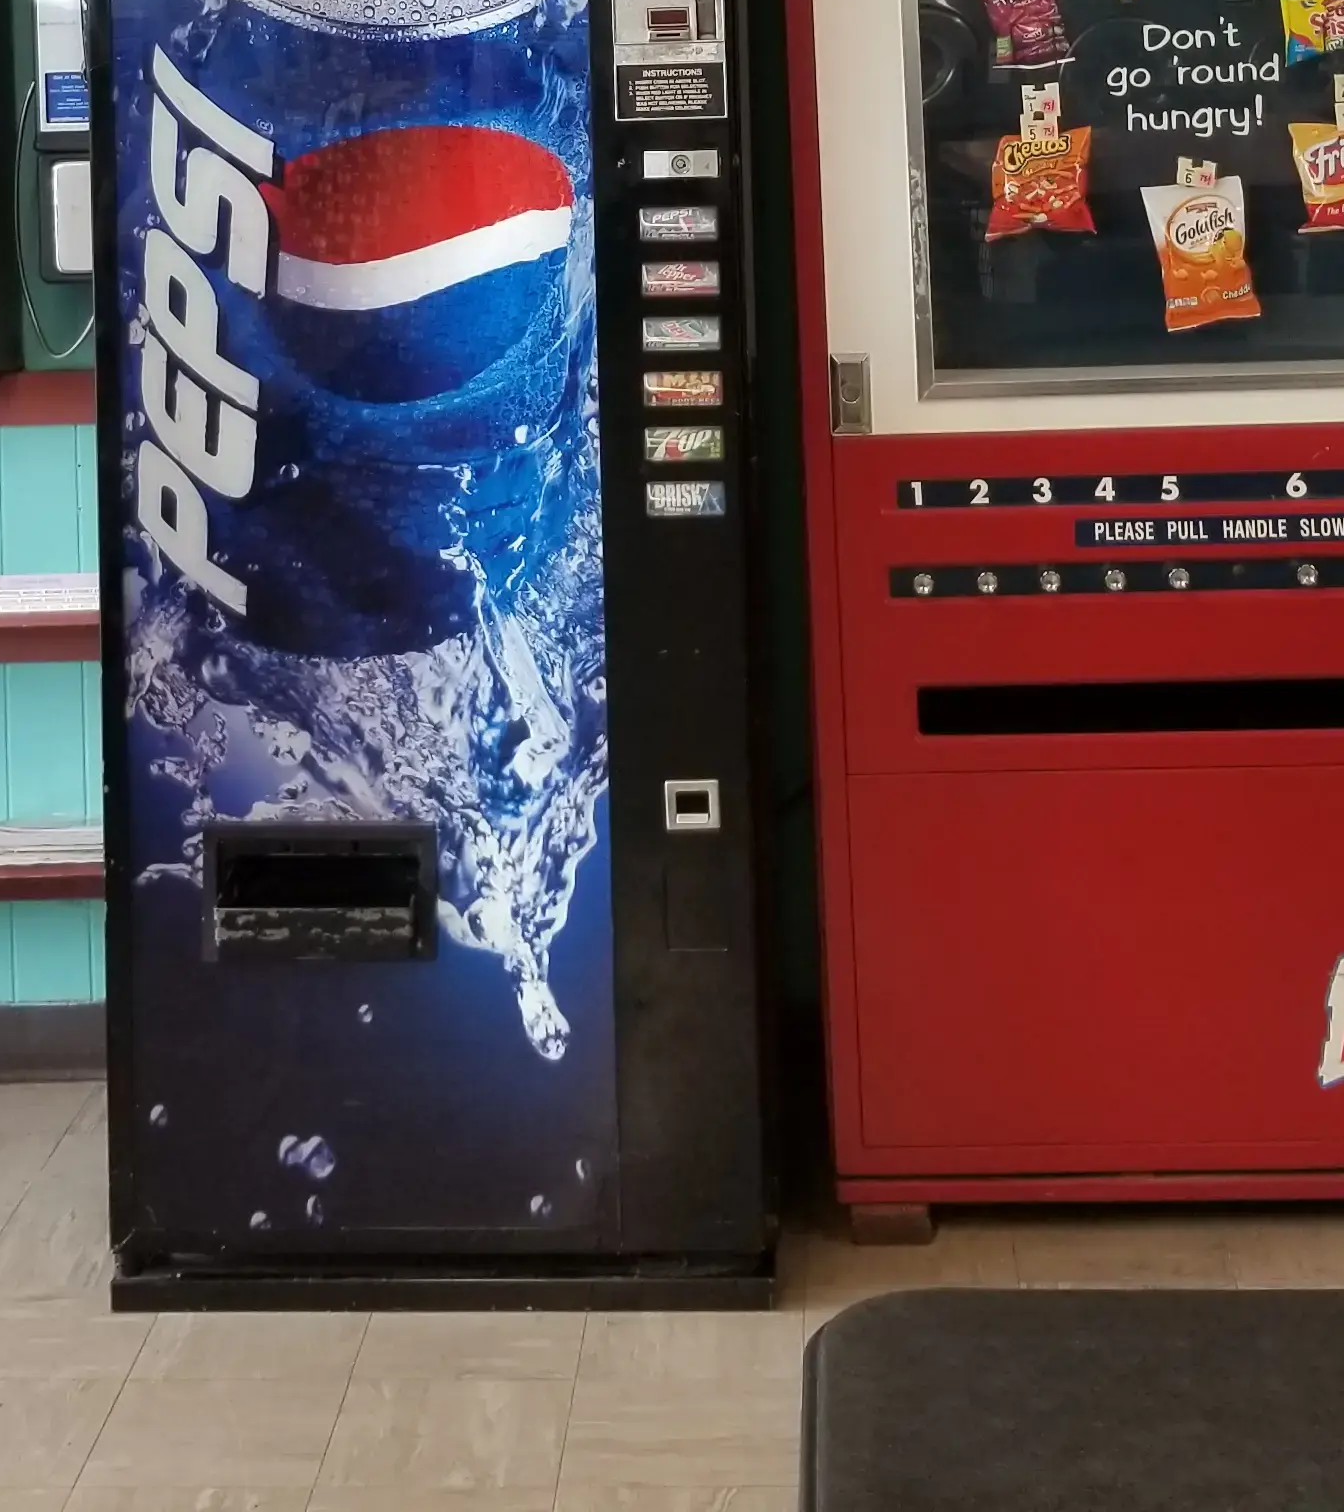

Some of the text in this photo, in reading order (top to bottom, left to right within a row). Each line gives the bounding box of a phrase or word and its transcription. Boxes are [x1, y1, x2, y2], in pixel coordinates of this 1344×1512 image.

[1142, 16, 1242, 52] Don't
[642, 69, 702, 77] INSTRUCTIONS
[1107, 52, 1280, 97] go 'round
[1127, 94, 1263, 138] hungry!
[1030, 129, 1035, 140] 5
[1004, 136, 1069, 172] Cheetos
[1185, 173, 1192, 183] 6
[652, 209, 692, 224] PEPSI
[1175, 208, 1234, 244] Goldfish
[138, 42, 274, 617] PEPSI
[655, 483, 702, 508] BRISK
[911, 482, 924, 506] 1
[969, 478, 990, 505] 2
[1032, 477, 1053, 504] 3
[1094, 476, 1116, 503] 4
[1160, 475, 1180, 501] 5
[1285, 472, 1308, 498] 6
[1094, 517, 1156, 542] PLEASE
[1166, 516, 1209, 540] PULL
[1222, 515, 1288, 539] HANDLE
